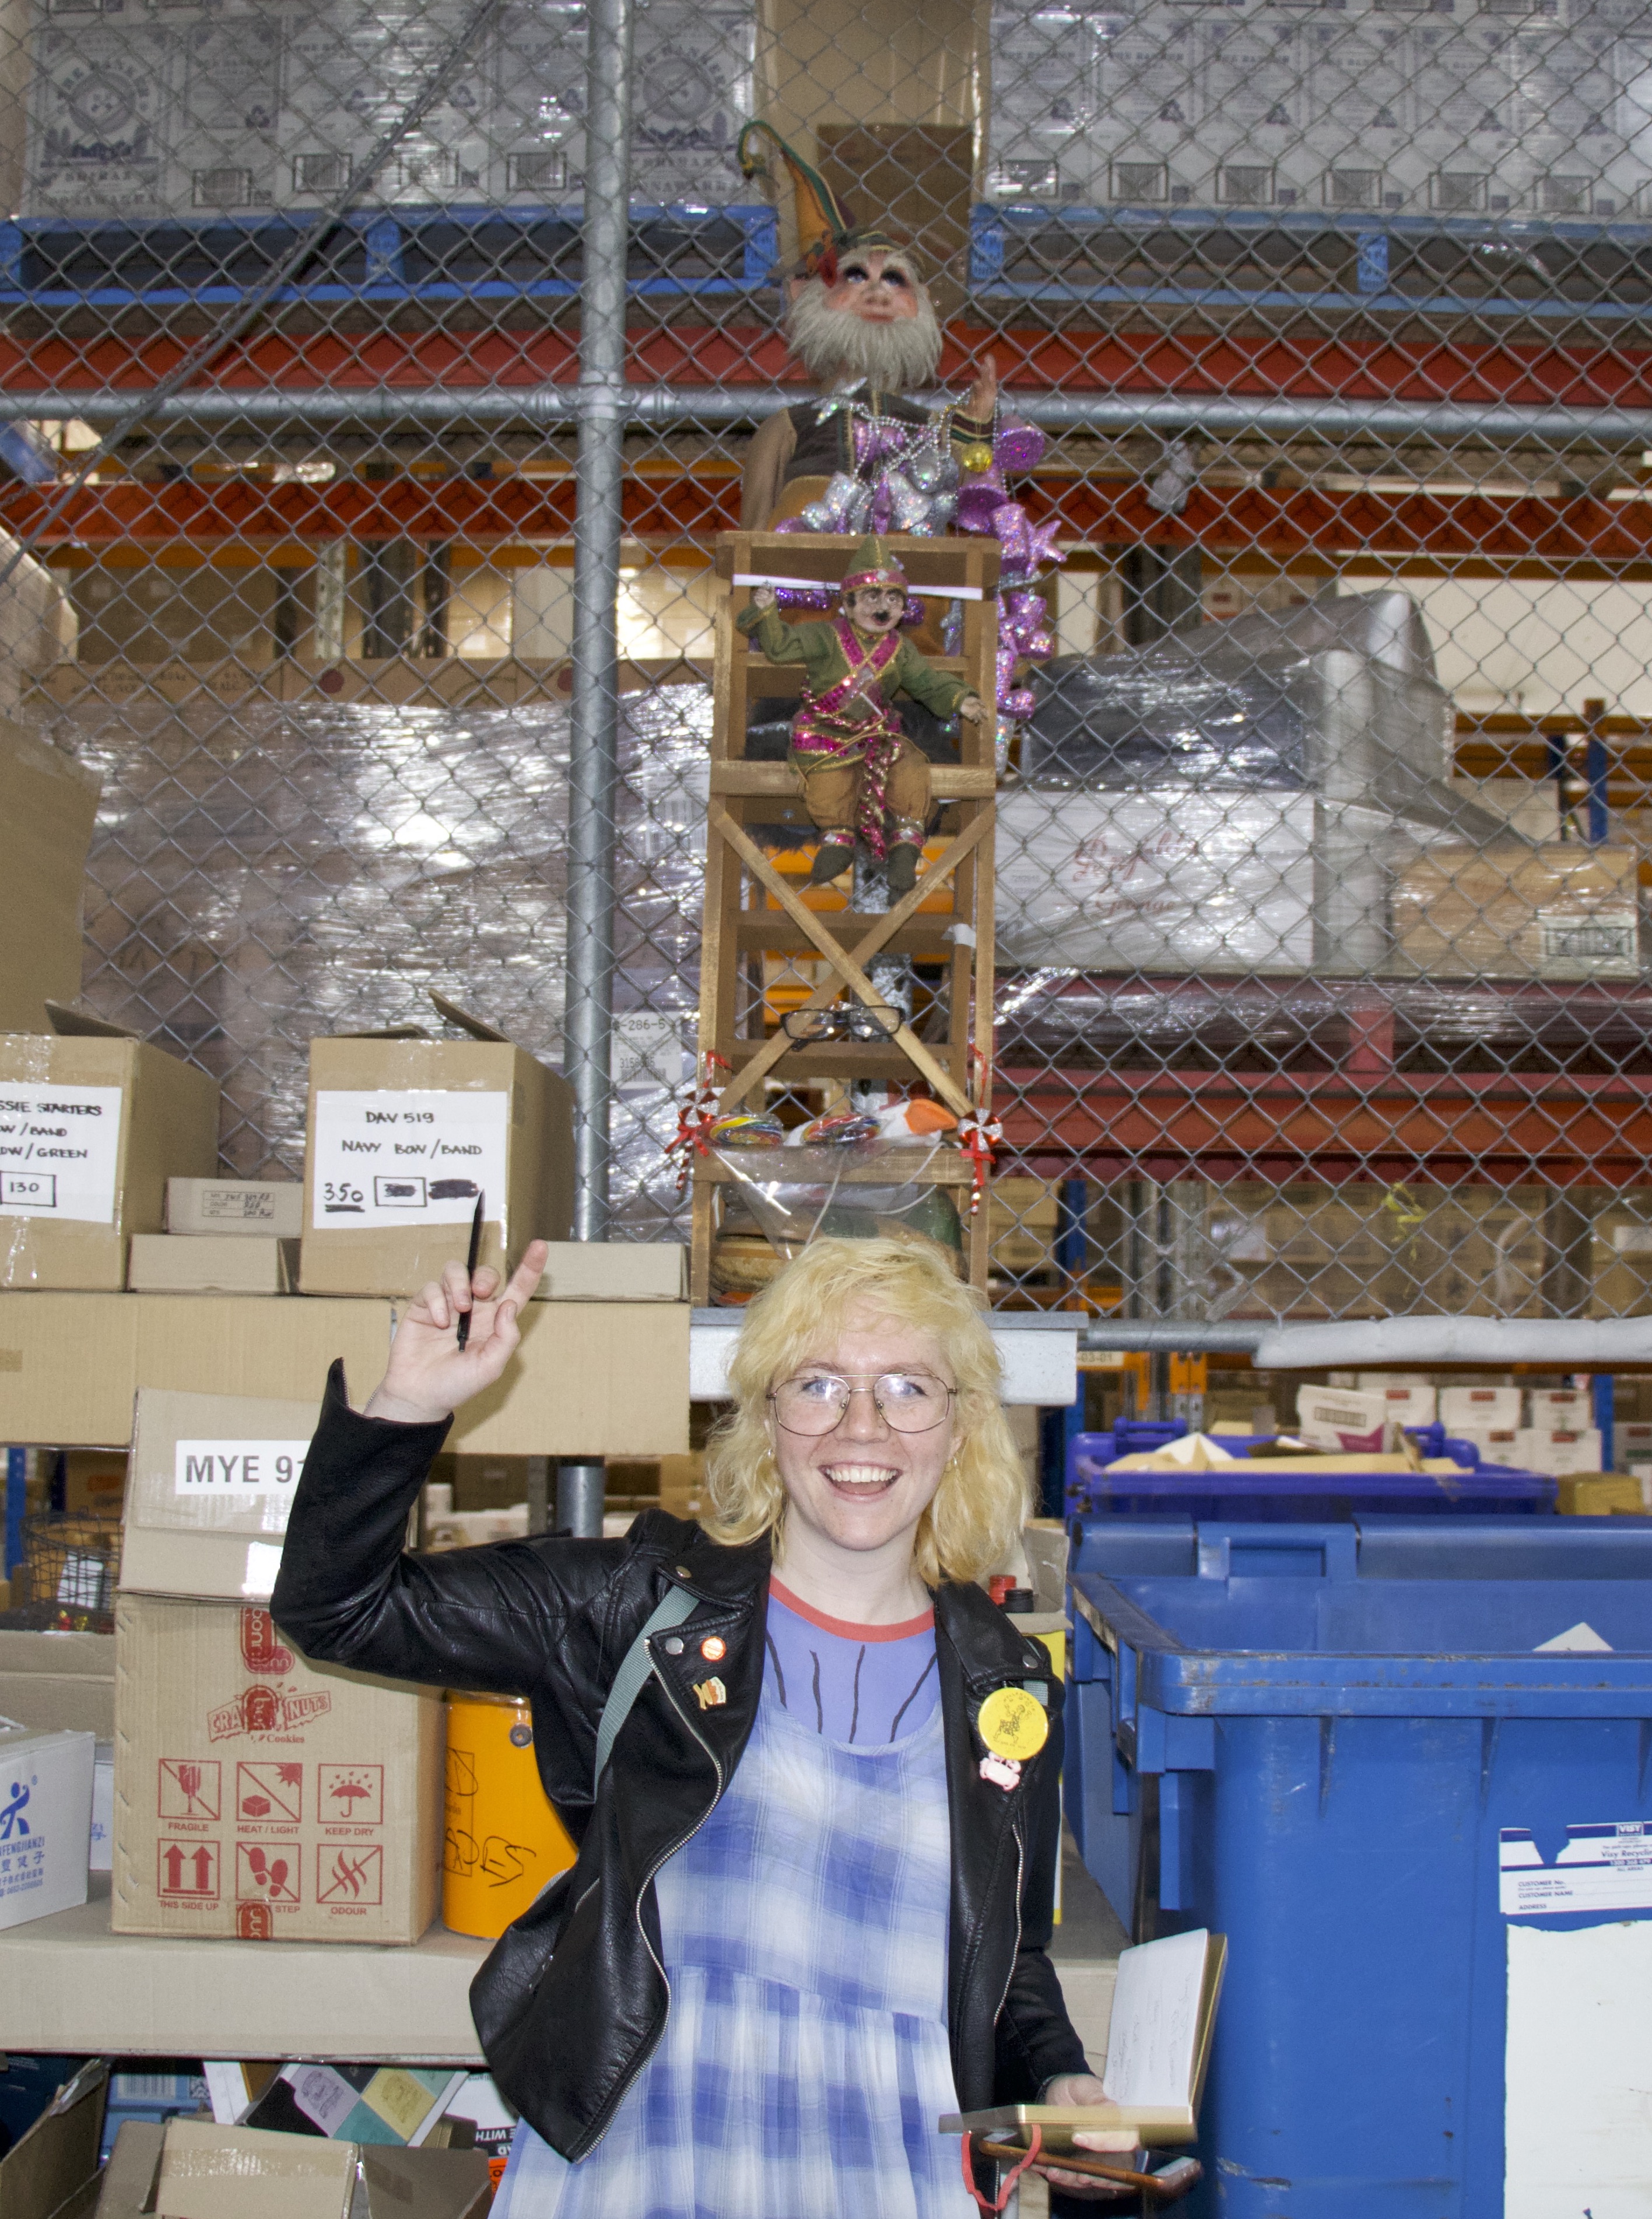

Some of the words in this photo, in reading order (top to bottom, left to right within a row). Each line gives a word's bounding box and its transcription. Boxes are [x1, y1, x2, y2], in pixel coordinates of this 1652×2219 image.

[620, 1018, 666, 1031] -286-5
[37, 1103, 103, 1116] STARTERS
[366, 1111, 398, 1124] DAV
[404, 1112, 434, 1123] 519
[342, 1140, 381, 1152] NAVY
[10, 1181, 40, 1193] 130
[324, 1182, 364, 1203] 350
[185, 1455, 260, 1483] MYE
[276, 1455, 306, 1483] 9
[287, 1695, 328, 1722] NUTS
[266, 1733, 305, 1743] Cookies
[168, 1822, 209, 1832] FRAGILE
[237, 1825, 262, 1834] HEAT
[271, 1825, 300, 1834] LIGHT
[325, 1827, 351, 1835] KEEP
[354, 1828, 374, 1836] DRY
[1619, 1824, 1642, 1832] VISY
[160, 1900, 179, 1909] THIS
[181, 1901, 203, 1910] SIDE
[206, 1902, 219, 1910] UP
[275, 1905, 301, 1913] STEP
[331, 1906, 367, 1915] ODOUR
[475, 2130, 506, 2141] WITH
